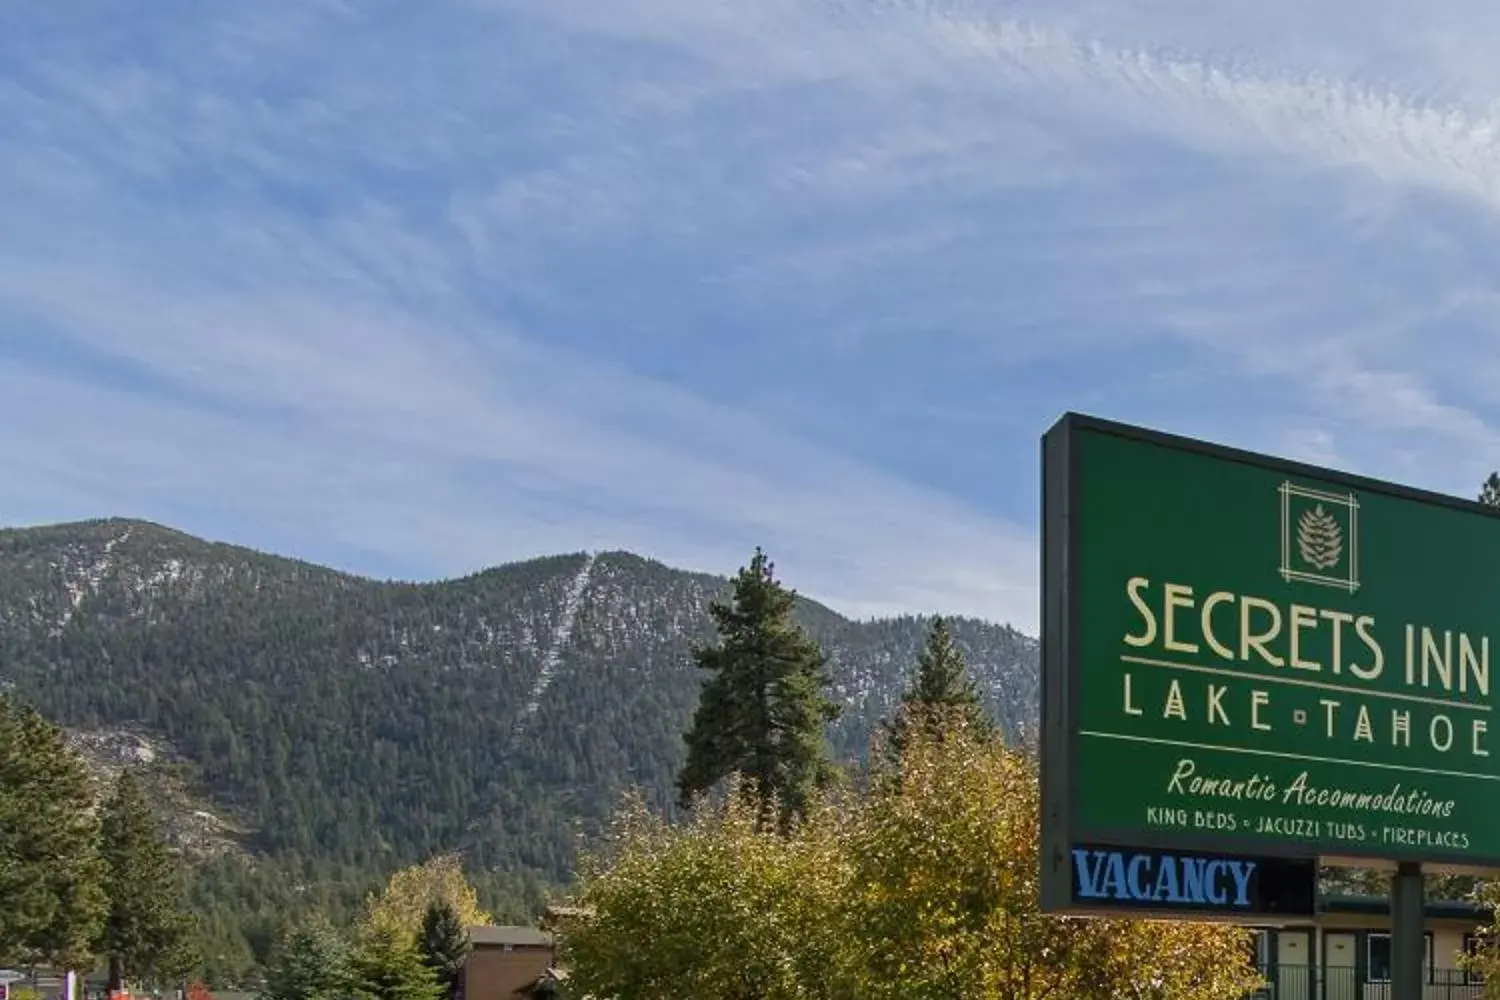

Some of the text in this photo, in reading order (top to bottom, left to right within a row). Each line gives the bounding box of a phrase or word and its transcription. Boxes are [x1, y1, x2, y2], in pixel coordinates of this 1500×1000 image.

[1123, 576, 1489, 696] SECRETS INN
[1124, 673, 1490, 756] LAKE TAHOE
[1167, 759, 1456, 818] Romantic Accommodations
[1147, 807, 1469, 849] KING BEDS JACUZZI TUBS FIREPLACES
[1072, 848, 1256, 905] VACANCY
